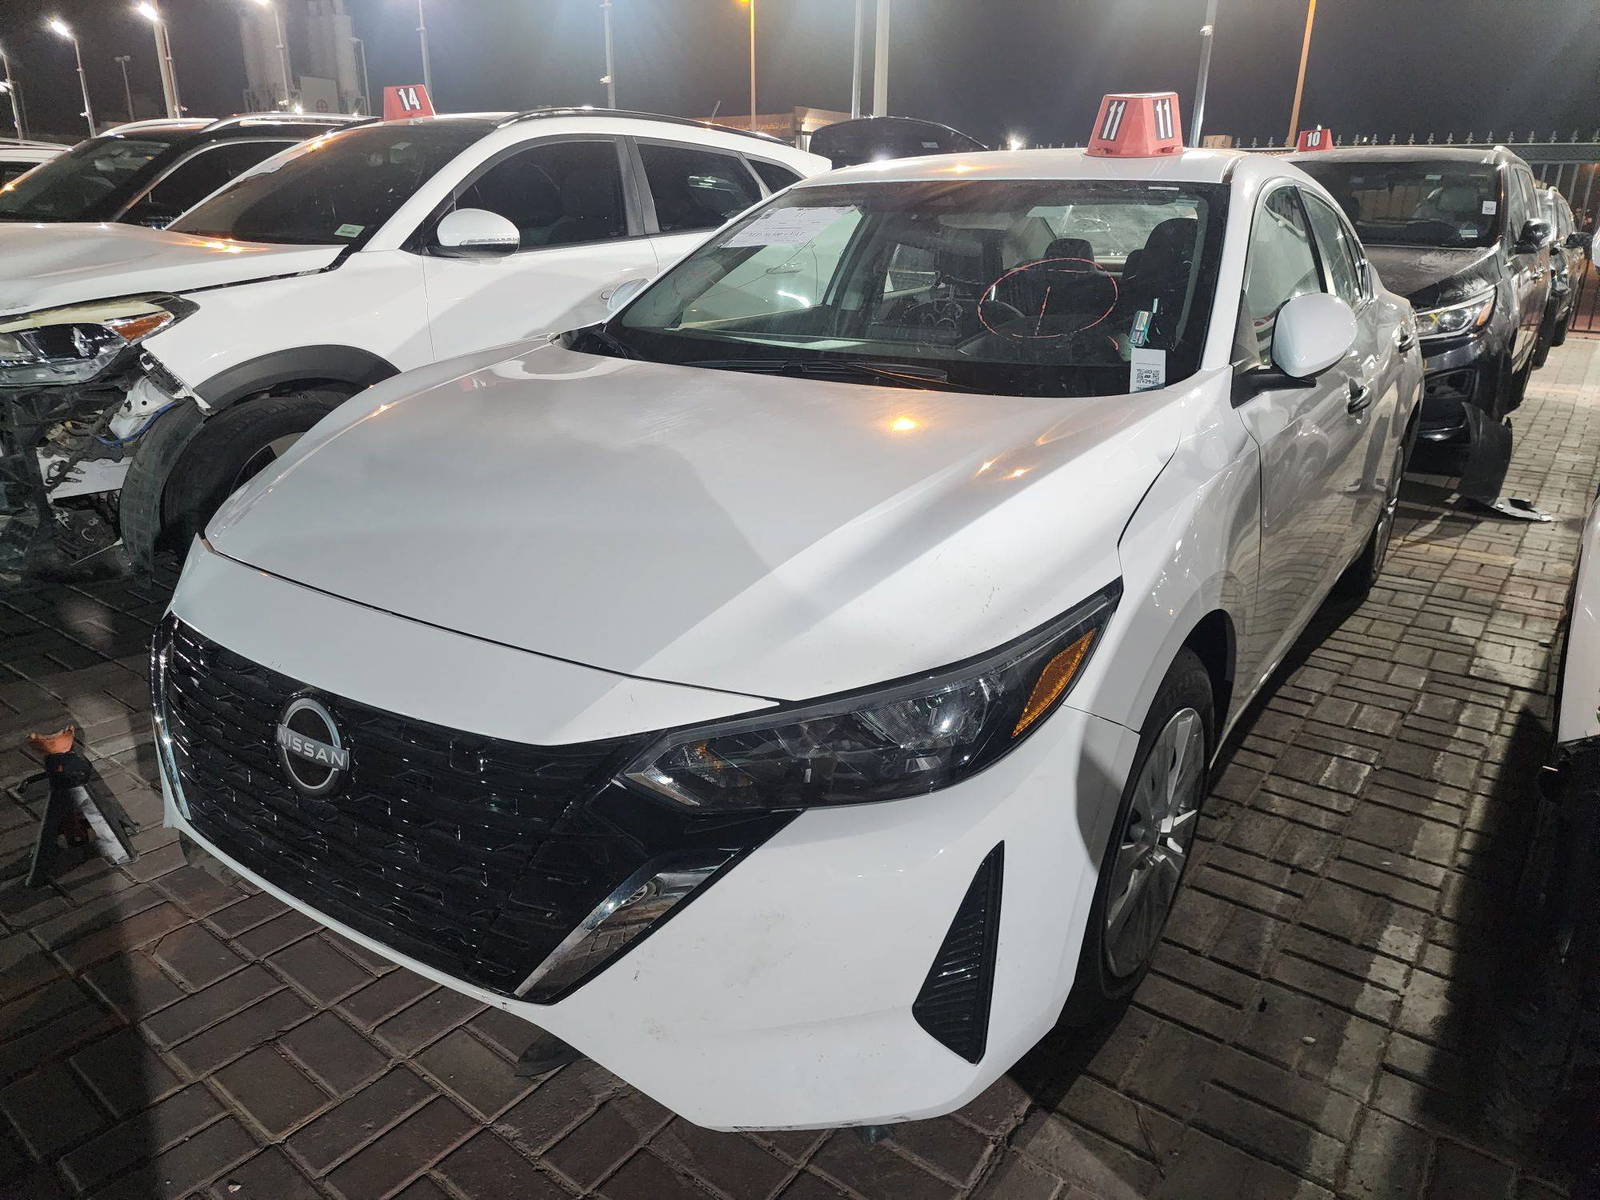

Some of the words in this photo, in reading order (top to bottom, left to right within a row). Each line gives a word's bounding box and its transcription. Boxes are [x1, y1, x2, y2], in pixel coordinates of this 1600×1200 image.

[398, 88, 420, 110] 14
[1102, 101, 1126, 140] 11
[1156, 99, 1173, 139] 11
[1307, 132, 1321, 147] 10
[279, 726, 345, 767] NISSAN
